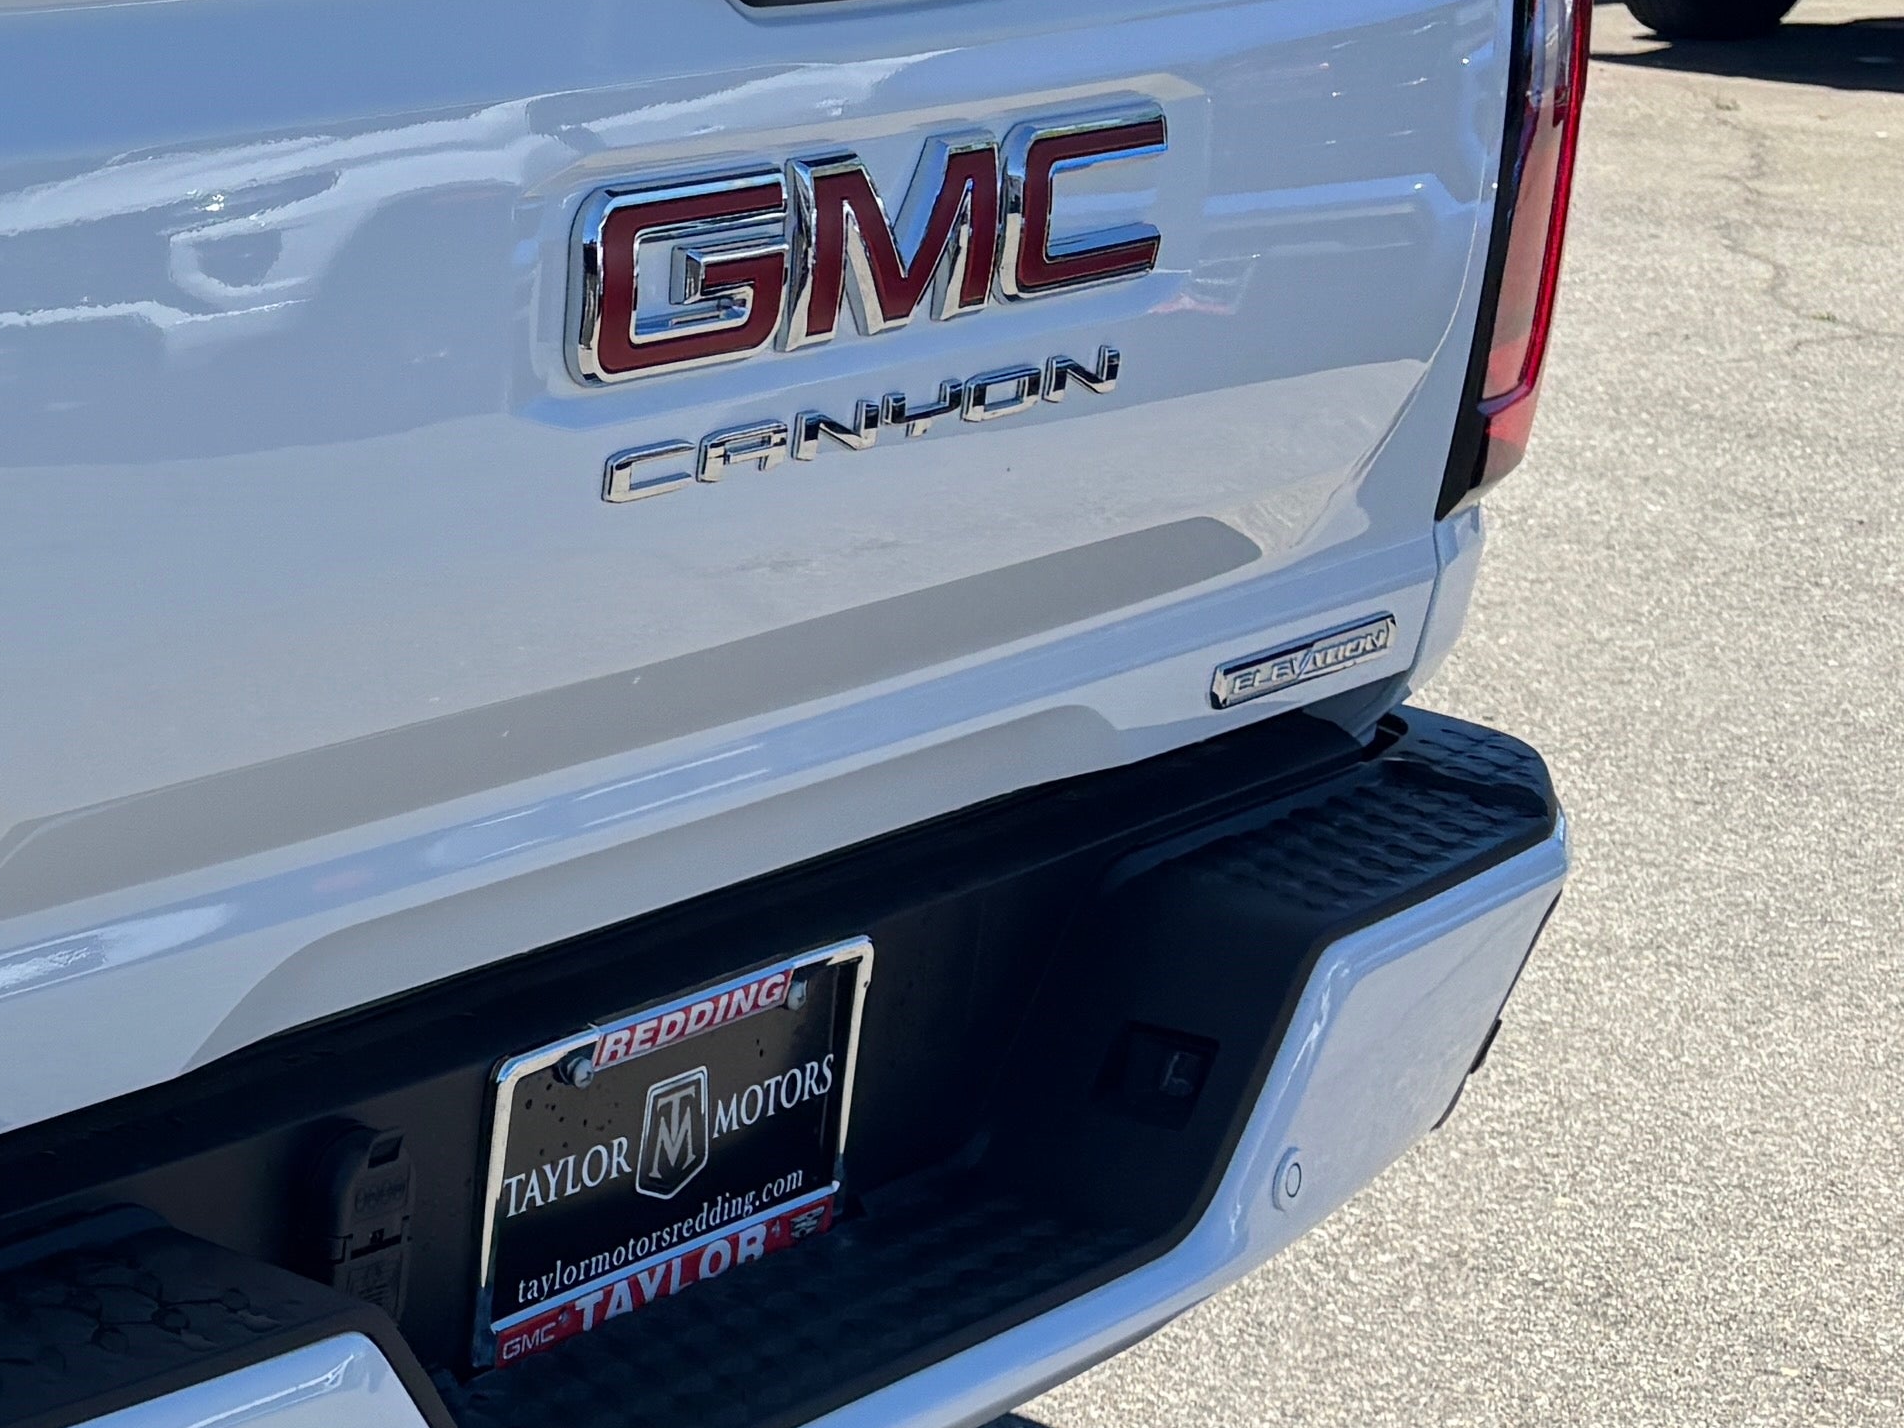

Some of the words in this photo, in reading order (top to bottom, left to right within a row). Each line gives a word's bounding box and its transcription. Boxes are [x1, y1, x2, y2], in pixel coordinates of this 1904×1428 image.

[567, 101, 1168, 387] GMC
[602, 344, 1122, 504] CANYON
[1232, 628, 1388, 695] ELEVATION
[599, 972, 787, 1066] REDDING
[504, 1135, 633, 1219] TAYLOR
[711, 1052, 835, 1139] MOTORS
[502, 1321, 557, 1361] GMC
[574, 1221, 768, 1333] TAYLOR
[517, 1168, 804, 1310] taylormotorsredding.com
